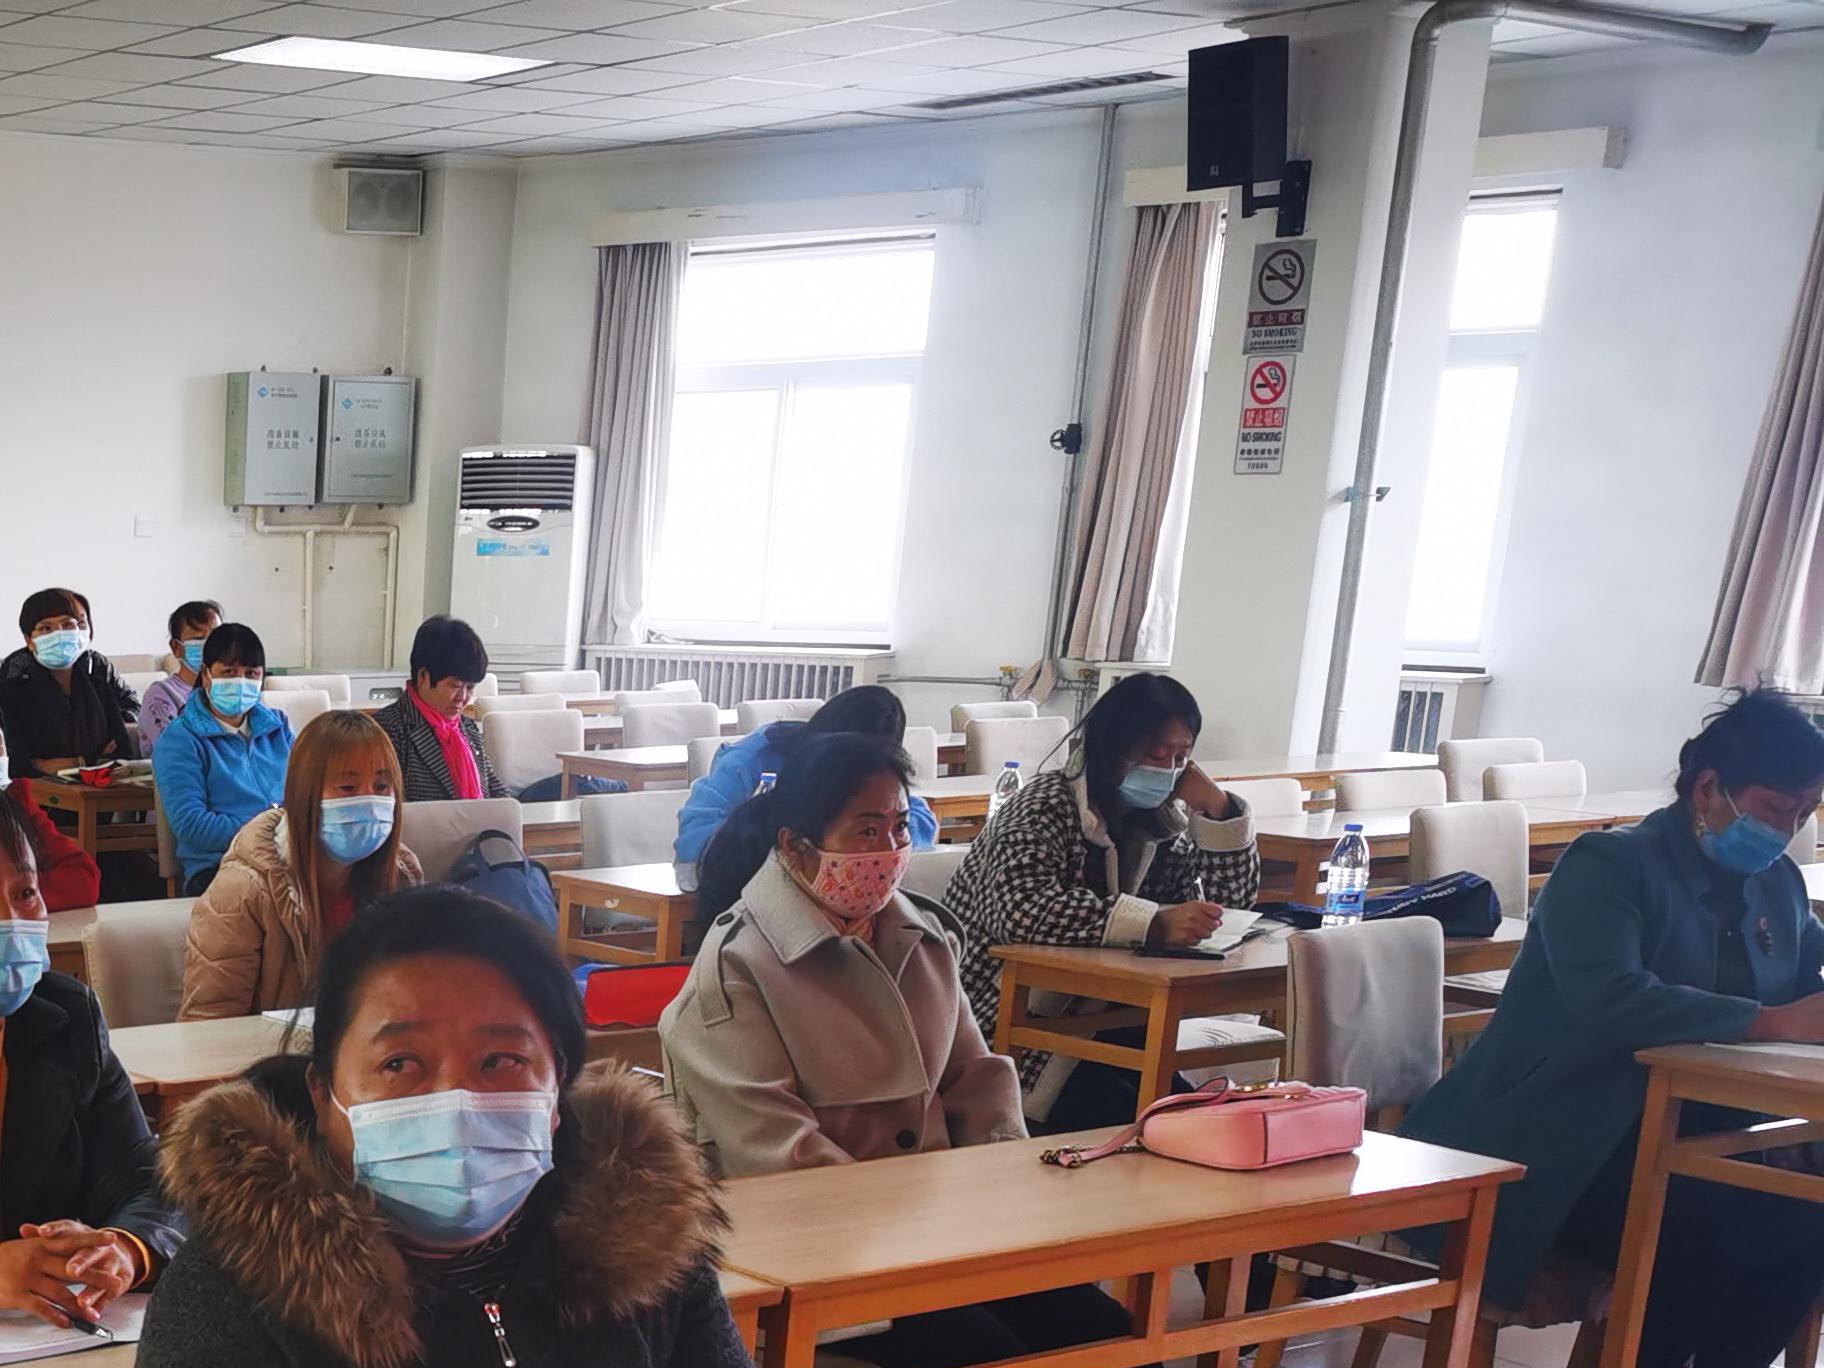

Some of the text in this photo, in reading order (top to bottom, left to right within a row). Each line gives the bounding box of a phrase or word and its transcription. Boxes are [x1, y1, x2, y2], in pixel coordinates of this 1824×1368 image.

[1252, 327, 1298, 338] NO SMOKING
[1241, 431, 1251, 443] NO
